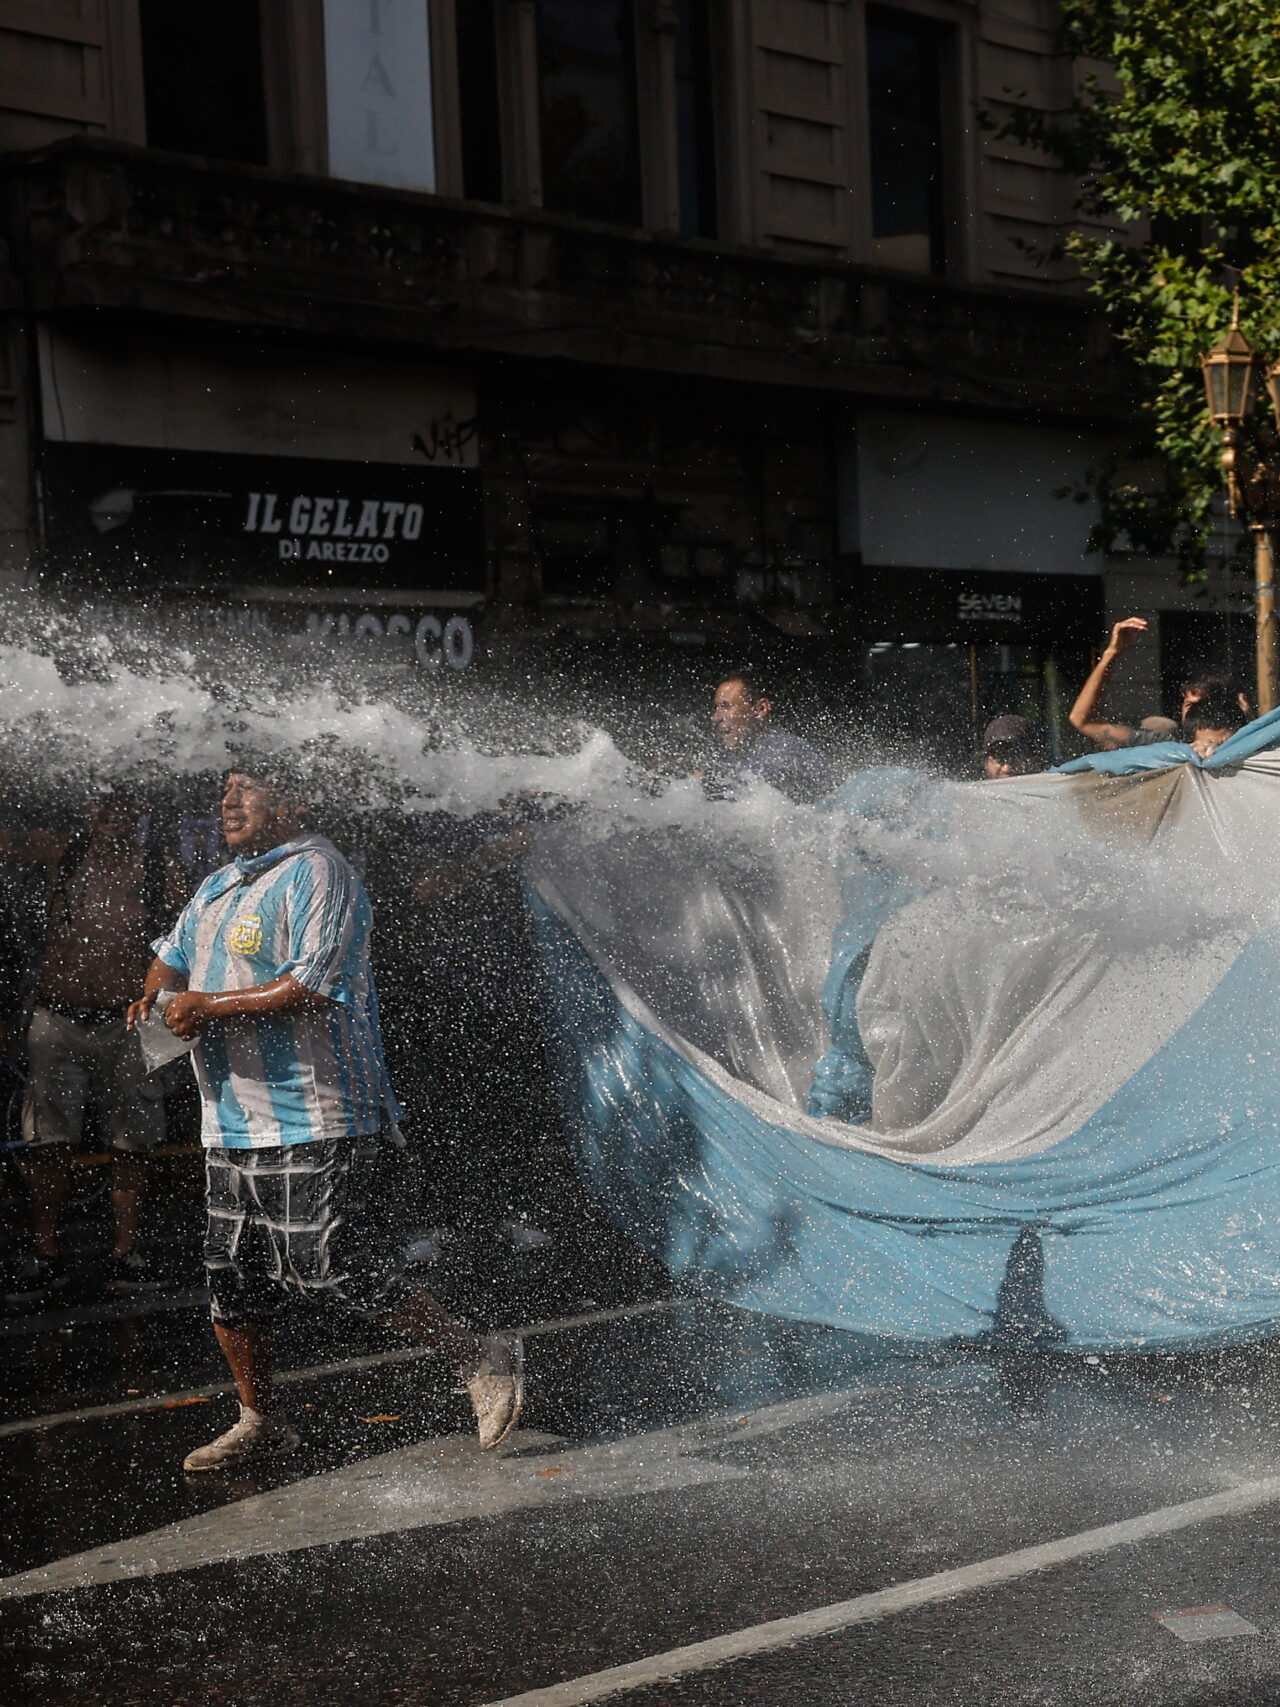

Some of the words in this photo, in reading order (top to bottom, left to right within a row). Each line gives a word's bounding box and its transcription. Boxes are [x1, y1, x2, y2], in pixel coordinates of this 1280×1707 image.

[243, 492, 283, 533] IL
[288, 496, 424, 541] GELATO
[278, 538, 300, 561] DI
[306, 539, 389, 564] AREZZO
